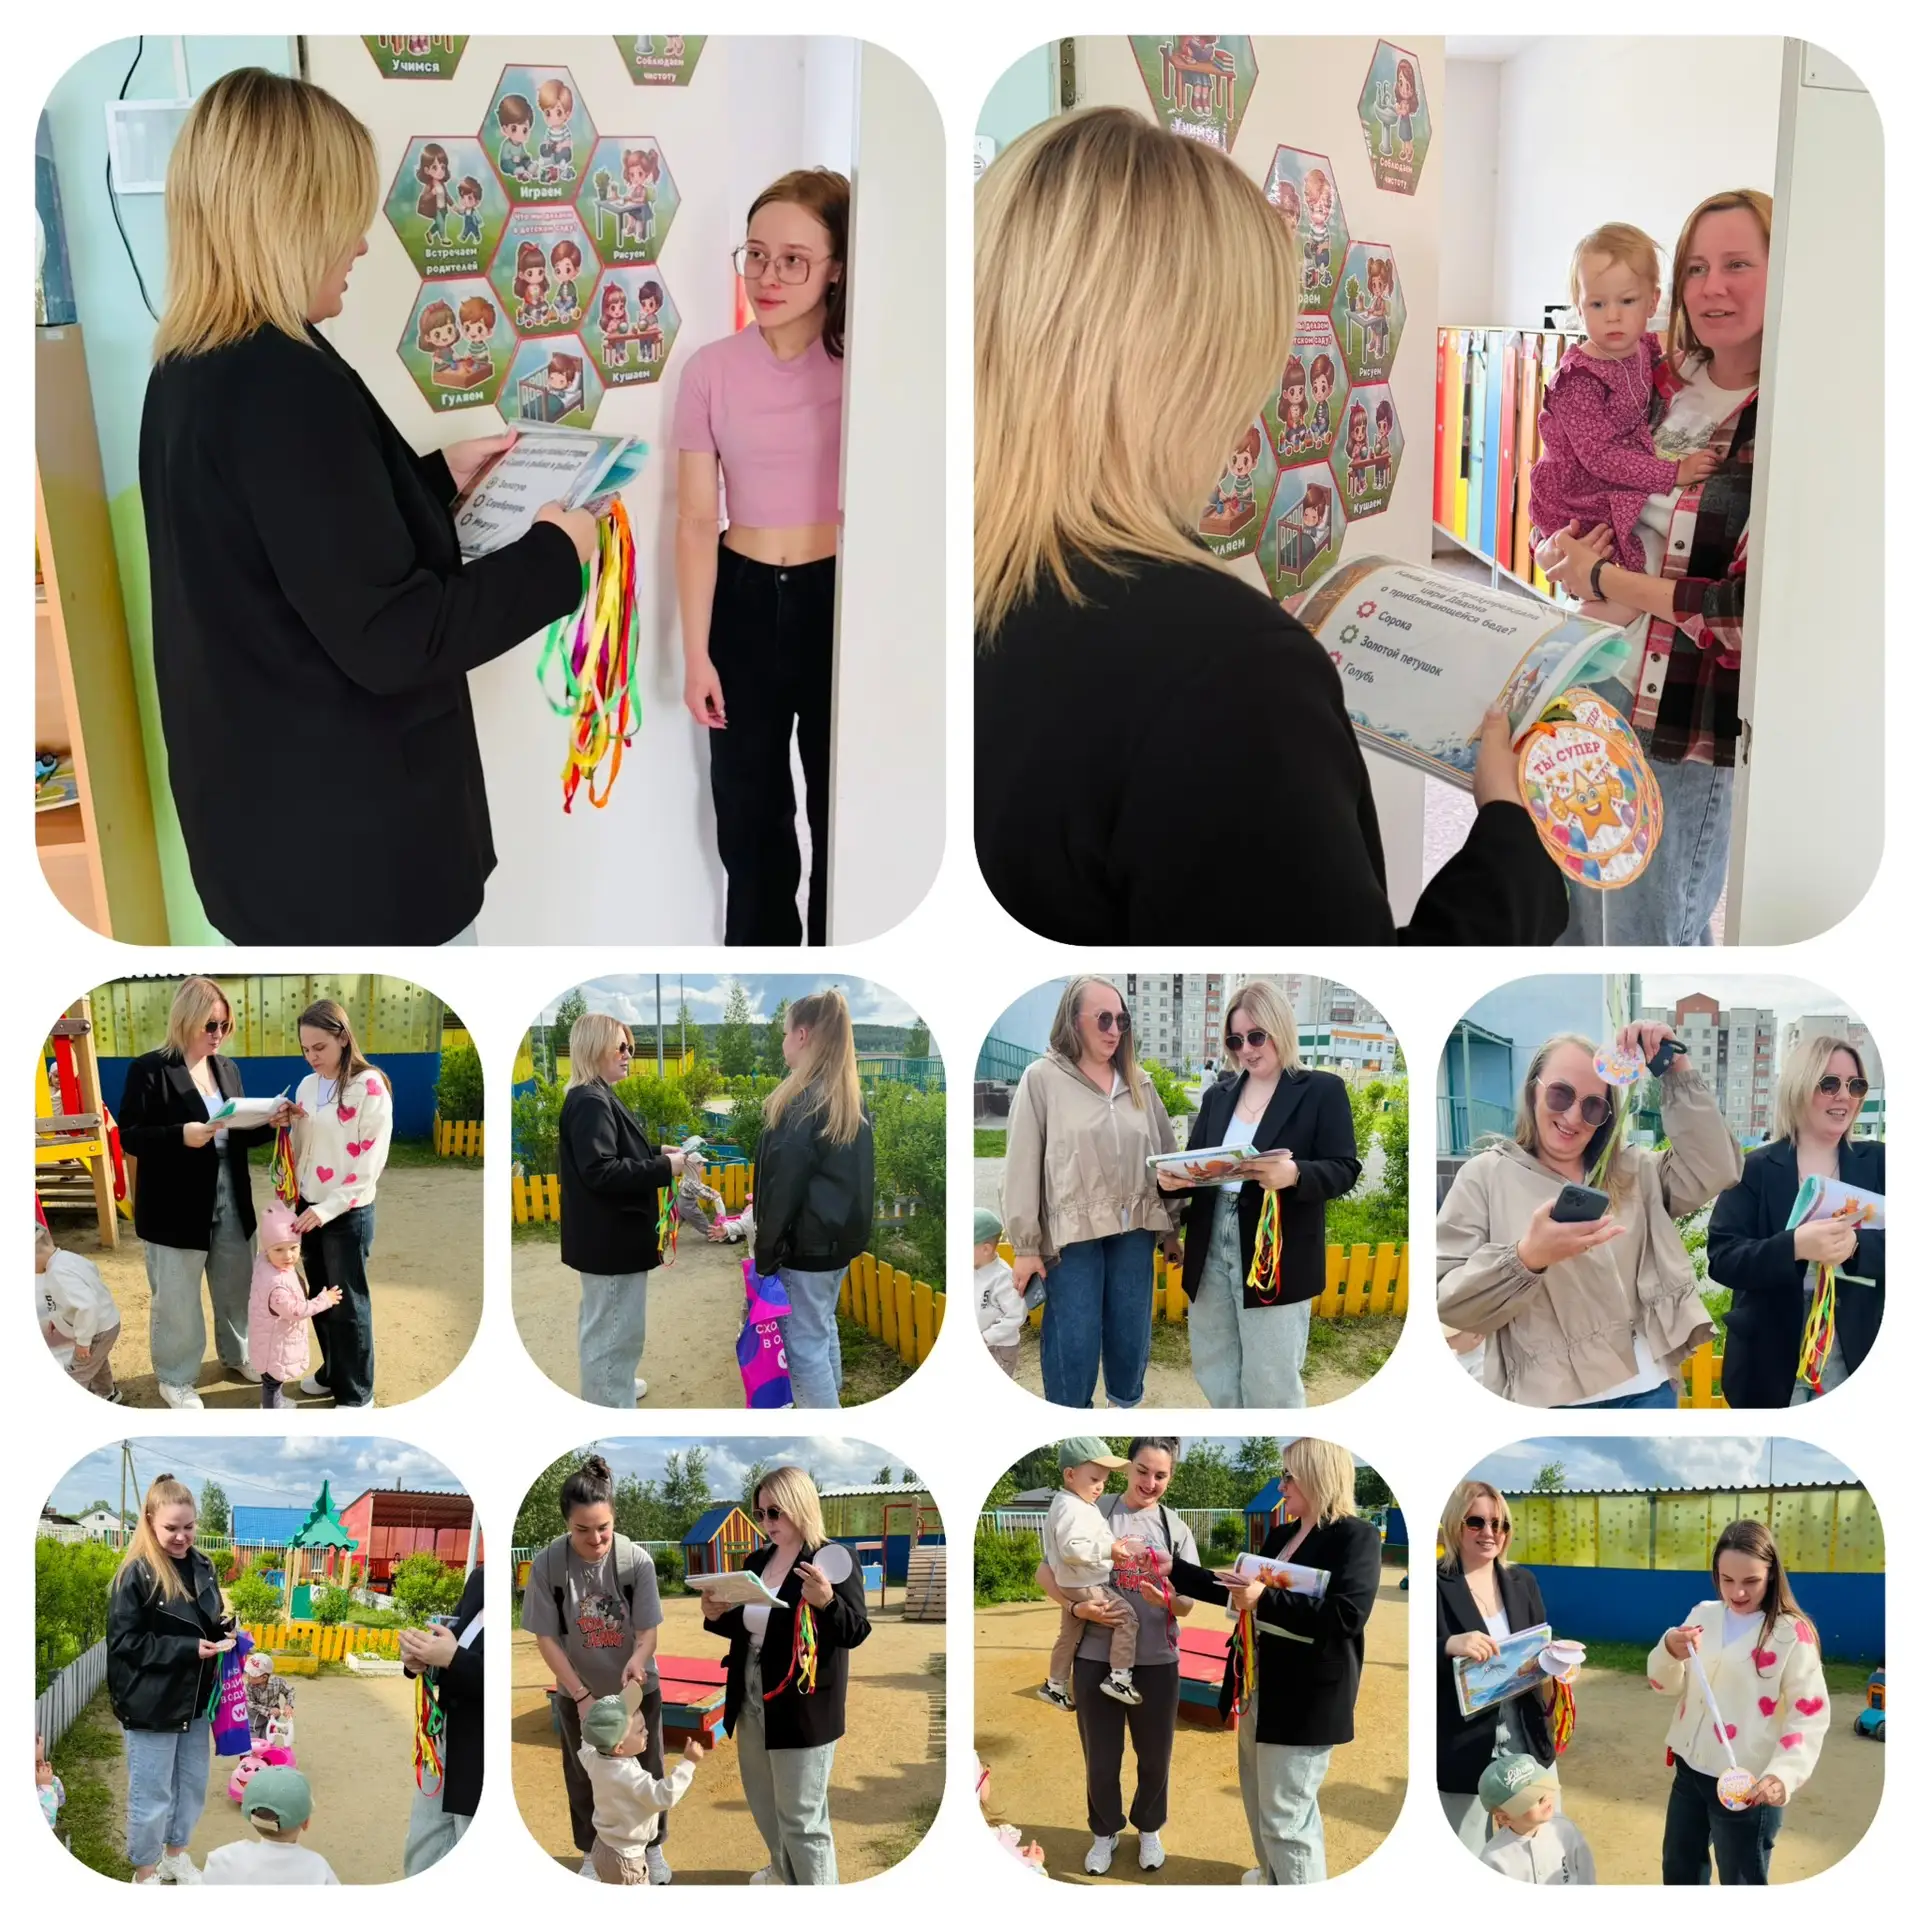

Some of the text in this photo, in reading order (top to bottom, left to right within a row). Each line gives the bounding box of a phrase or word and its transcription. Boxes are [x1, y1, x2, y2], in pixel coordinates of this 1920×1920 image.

[392, 59, 440, 73] Учимся
[635, 55, 685, 67] Соблюдаем
[643, 71, 677, 84] чистоту
[520, 186, 562, 200] Играем
[425, 247, 477, 258] Встречаем
[613, 250, 645, 260] Рисуем
[426, 261, 478, 274] родителей
[1297, 293, 1321, 305] раем
[1293, 335, 1314, 346] тском
[612, 369, 650, 382] Кушаем
[1359, 367, 1382, 377] Рисуем
[441, 390, 484, 405] Гуляем
[1353, 499, 1382, 514] Кушаем
[1211, 538, 1246, 556] уляем
[1421, 587, 1488, 614] царя Дадона
[1389, 589, 1480, 624] приближающейся
[1482, 619, 1517, 636] беде?
[1378, 610, 1412, 632] Сорока
[1360, 635, 1443, 677] Золотой петушок
[1343, 662, 1376, 684] Голубь
[1534, 741, 1601, 776] ТЫ СУПЕР
[755, 1321, 779, 1334] СХО
[763, 1339, 771, 1348] В
[576, 1617, 605, 1634] TOM
